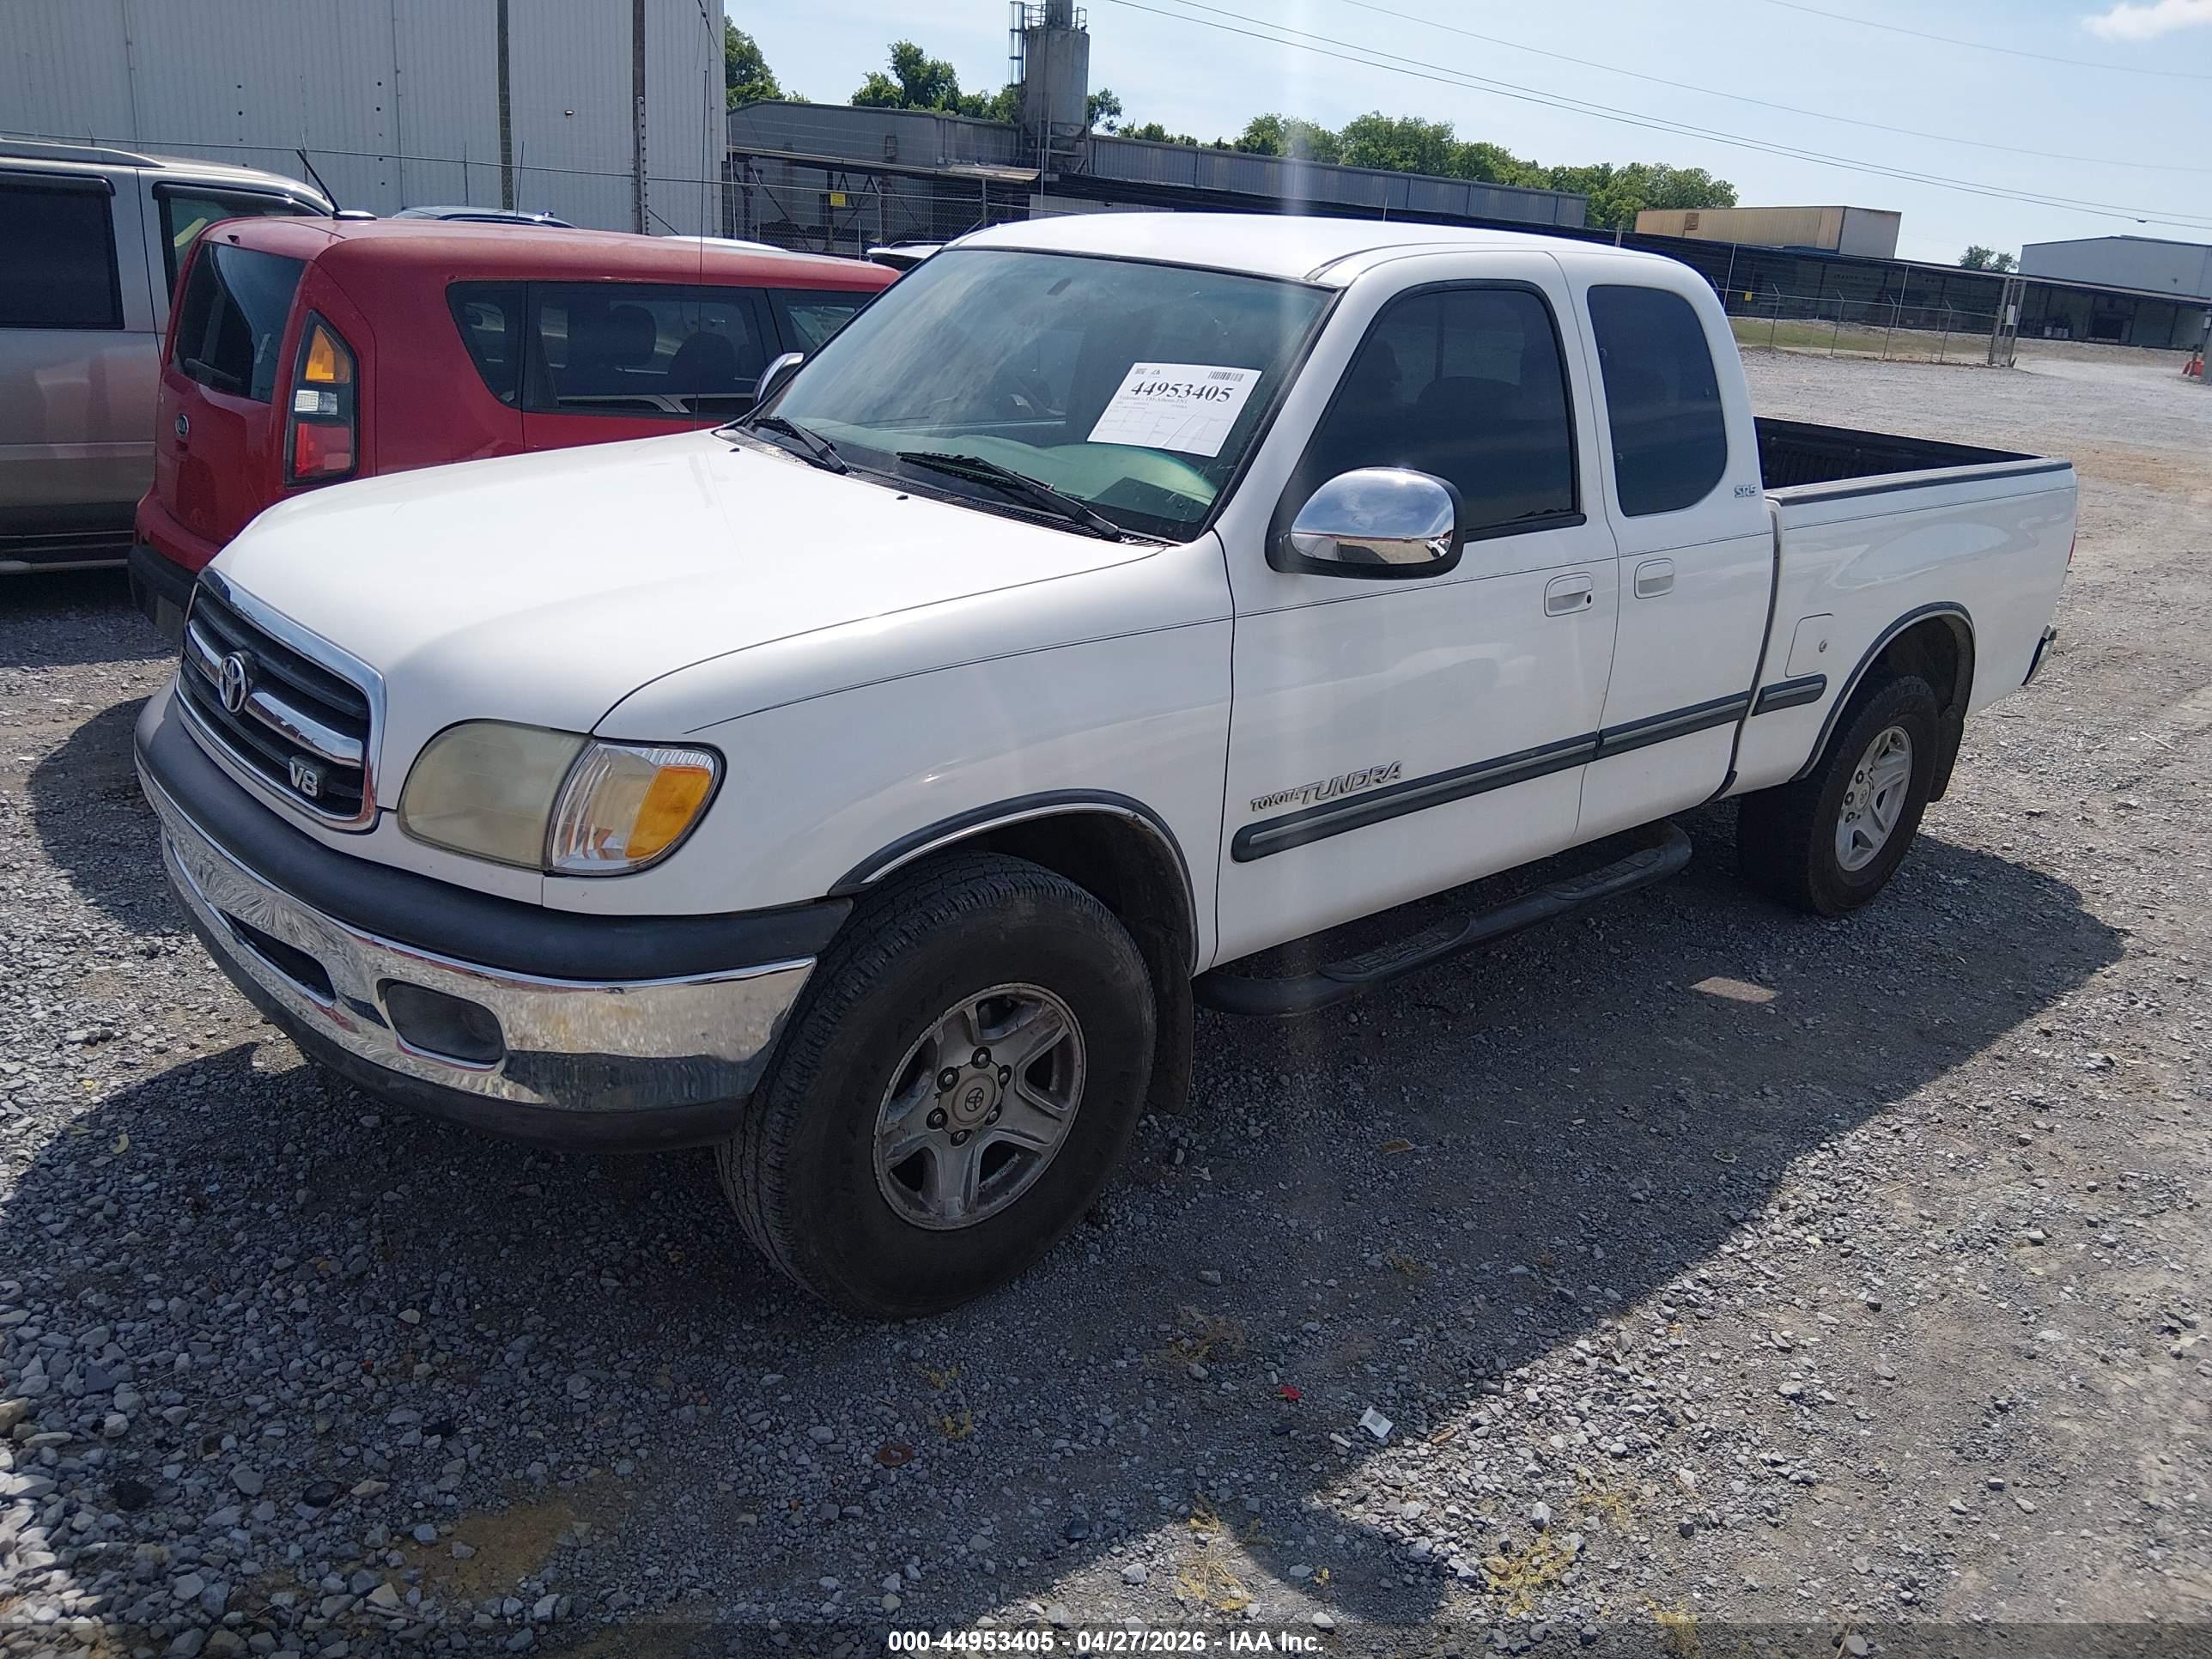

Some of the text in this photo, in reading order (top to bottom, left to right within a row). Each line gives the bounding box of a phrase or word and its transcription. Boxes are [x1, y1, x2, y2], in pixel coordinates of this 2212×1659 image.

[1131, 380, 1236, 403] 44953405
[1734, 484, 1758, 498] SR5
[289, 759, 318, 797] V8
[1249, 760, 1402, 812] TOYOTA TUNDRA
